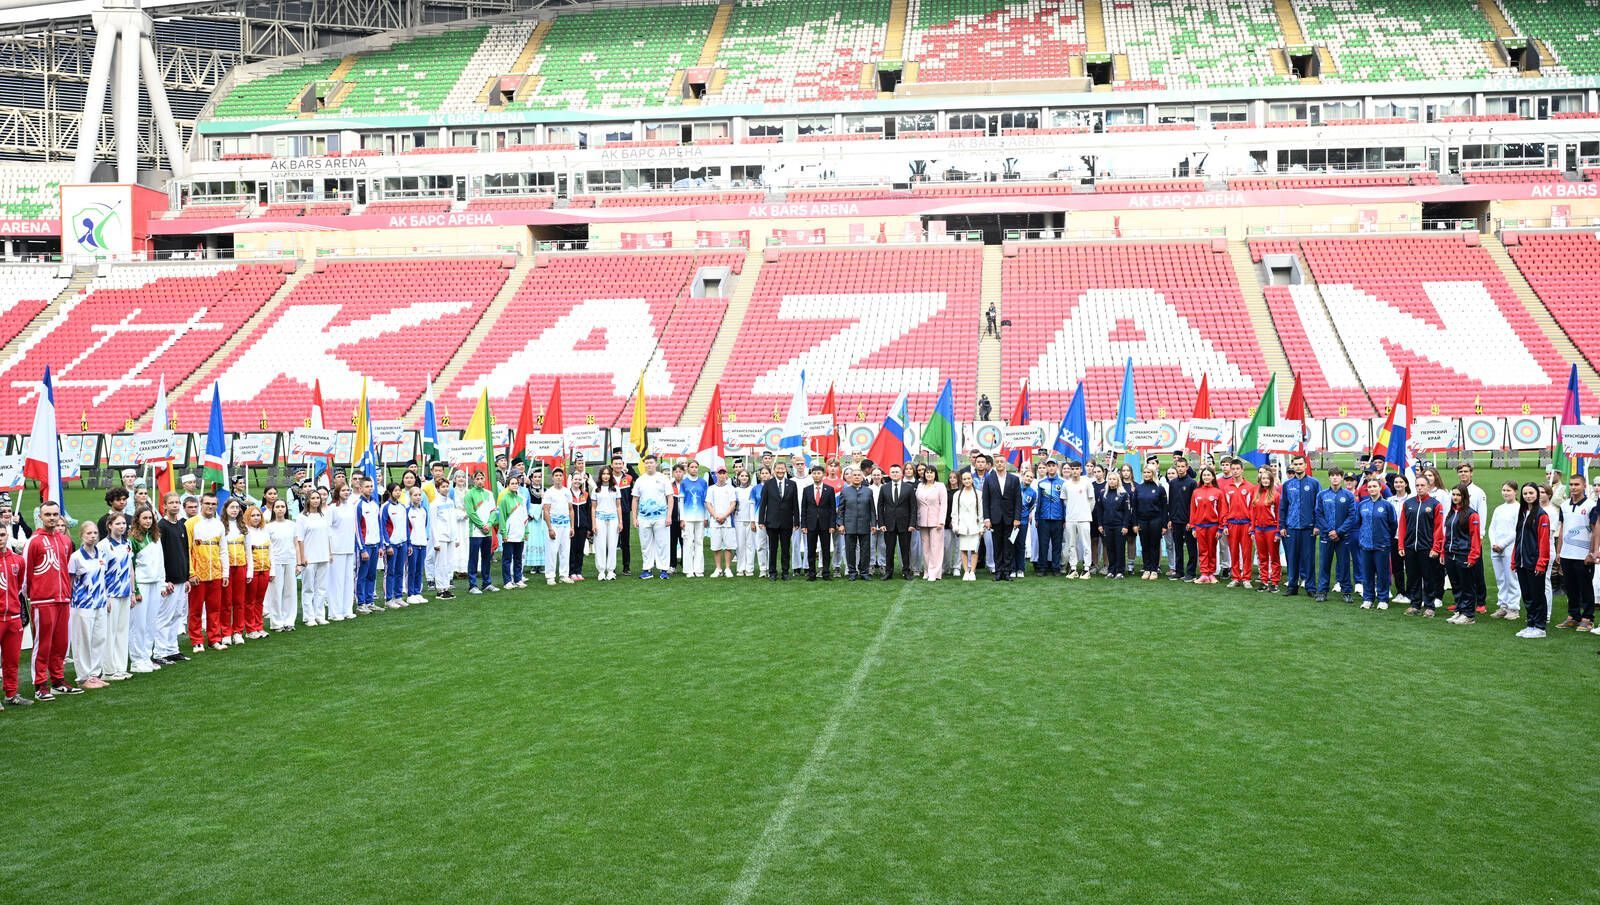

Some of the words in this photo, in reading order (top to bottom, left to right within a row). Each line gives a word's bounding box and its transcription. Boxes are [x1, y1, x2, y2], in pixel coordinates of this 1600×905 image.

[1506, 78, 1544, 90] БАРС
[1547, 77, 1597, 89] АРЕНА
[428, 114, 445, 126] AK
[448, 113, 480, 125] BARS
[483, 112, 526, 124] ARENA
[947, 139, 965, 149] AK
[1007, 136, 1056, 147] ARENA
[601, 149, 618, 159] АК
[621, 148, 655, 159] БАРС
[659, 146, 703, 158] АРЕНА
[270, 160, 287, 170] AK
[290, 159, 322, 169] BARS
[324, 158, 366, 169] ARENA
[1531, 184, 1553, 197] AK
[1556, 183, 1598, 196] BARS
[1128, 195, 1149, 208] АК
[1152, 194, 1192, 207] БАРС
[1194, 192, 1246, 205] АРЕНА
[748, 206, 768, 217] AK
[770, 205, 807, 216] BARS
[810, 203, 859, 215] ARENA
[389, 215, 407, 227] АК
[410, 214, 445, 226] БАРС
[447, 213, 494, 225] АРЕНА
[1, 222, 51, 233] ARENA
[193, 281, 1552, 402] KAZAN
[140, 438, 168, 446] РЕСПУБЛИКА
[300, 433, 330, 441] РЕСПУБЛИКА
